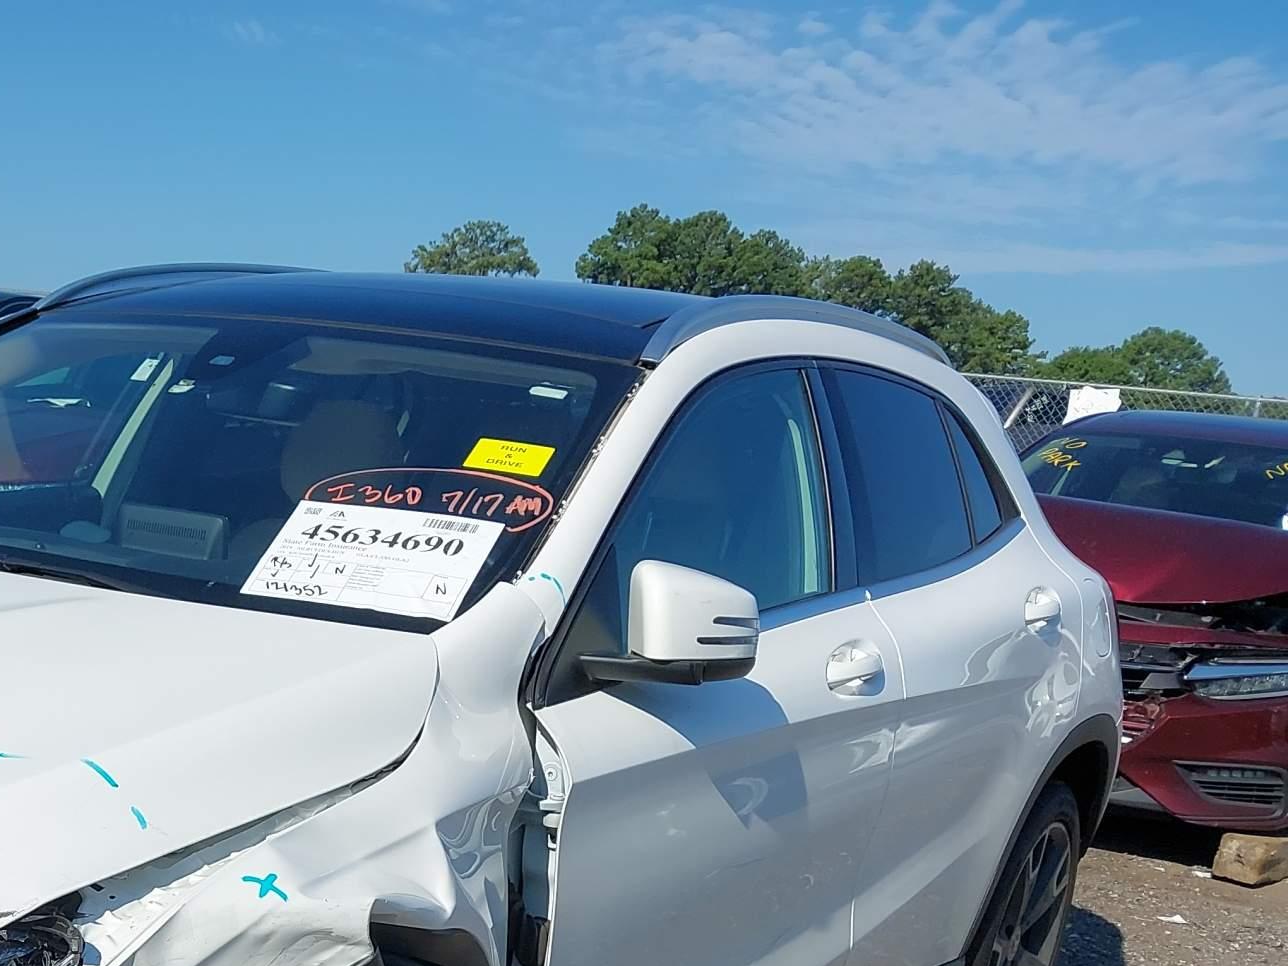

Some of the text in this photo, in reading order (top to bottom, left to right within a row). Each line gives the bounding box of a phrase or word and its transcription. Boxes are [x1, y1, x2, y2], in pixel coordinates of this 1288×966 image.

[500, 445, 527, 453] RUN
[486, 458, 524, 467] DRIVE
[1038, 448, 1082, 471] PARK
[442, 488, 503, 517] 7/17
[301, 523, 464, 556] 45634690
[334, 564, 346, 575] N
[435, 582, 447, 595] N
